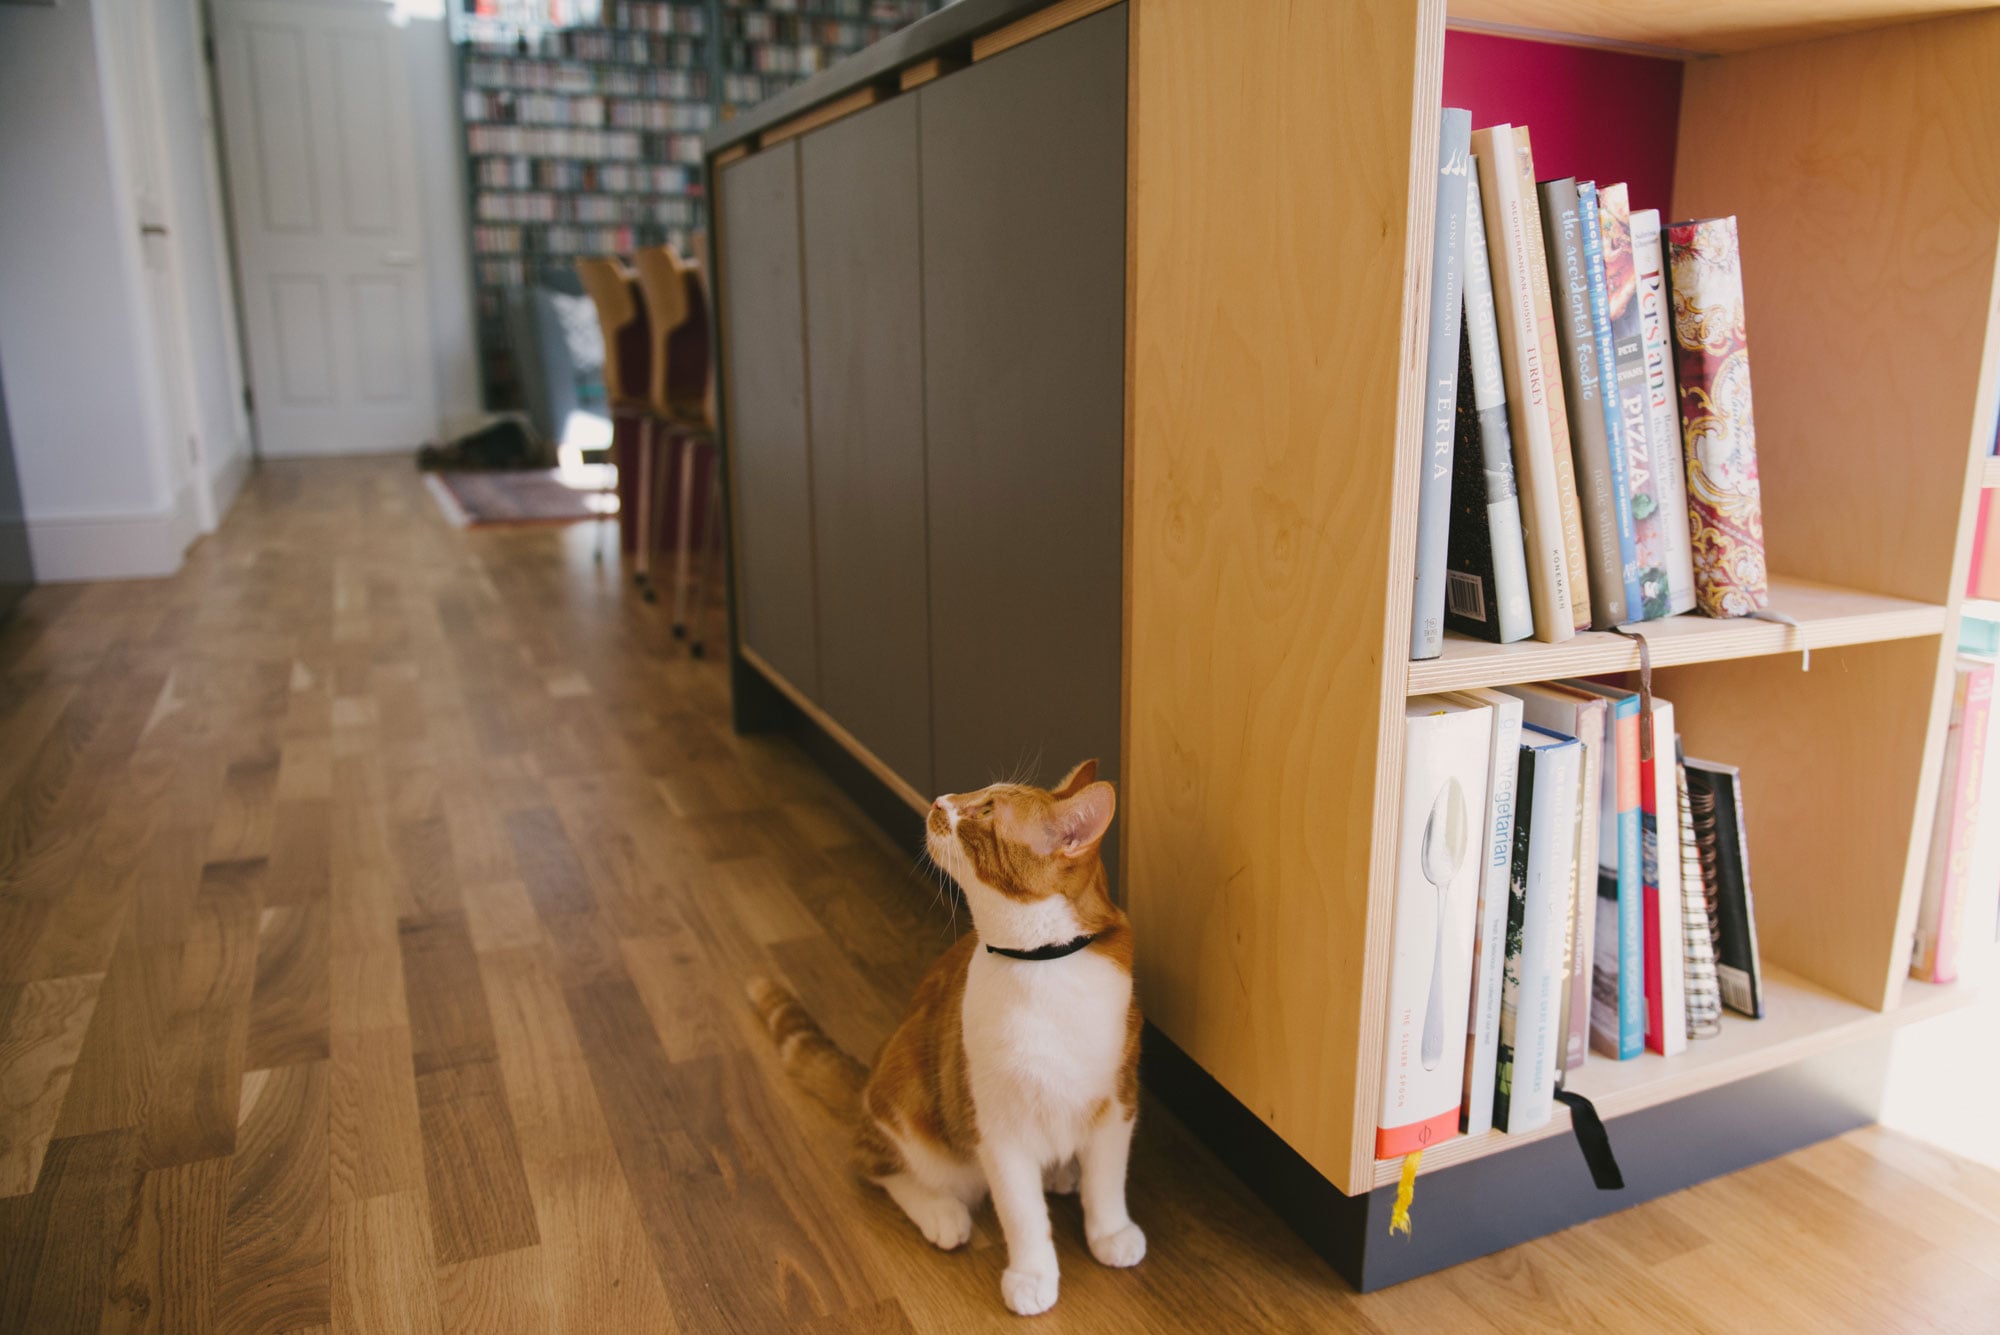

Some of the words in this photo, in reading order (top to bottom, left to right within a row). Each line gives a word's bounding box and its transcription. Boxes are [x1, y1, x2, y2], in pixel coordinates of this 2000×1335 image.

[1448, 213, 1457, 249] SONE
[1562, 209, 1579, 240] the
[1587, 201, 1599, 250] beach
[1447, 255, 1455, 265] &
[1467, 182, 1487, 281] Gordon
[1477, 292, 1501, 395] Ramsay
[1511, 200, 1528, 291] MEDITERRANEAN
[1520, 294, 1532, 334] CUISINE
[1567, 245, 1593, 338] accidental
[1444, 272, 1454, 336] DOUMANI
[1598, 298, 1609, 333] boat
[1617, 342, 1638, 357] PETE
[1640, 269, 1668, 408] Persiana
[1527, 344, 1543, 407] TURKEY
[1537, 315, 1570, 454] TUSCAN
[1577, 343, 1599, 400] foodie
[1602, 337, 1616, 408] barbecue
[1433, 373, 1454, 481] TERRA
[1622, 393, 1651, 491] PIZZA
[1594, 469, 1609, 506] neale
[1600, 511, 1615, 574] whitaker
[1625, 812, 1639, 883] COOKING
[1625, 885, 1639, 952] WITHOUT
[1402, 1007, 1411, 1025] THE
[1625, 955, 1640, 1025] BORDERS
[1400, 1033, 1409, 1067] SILVER
[1397, 1074, 1407, 1108] SPOON
